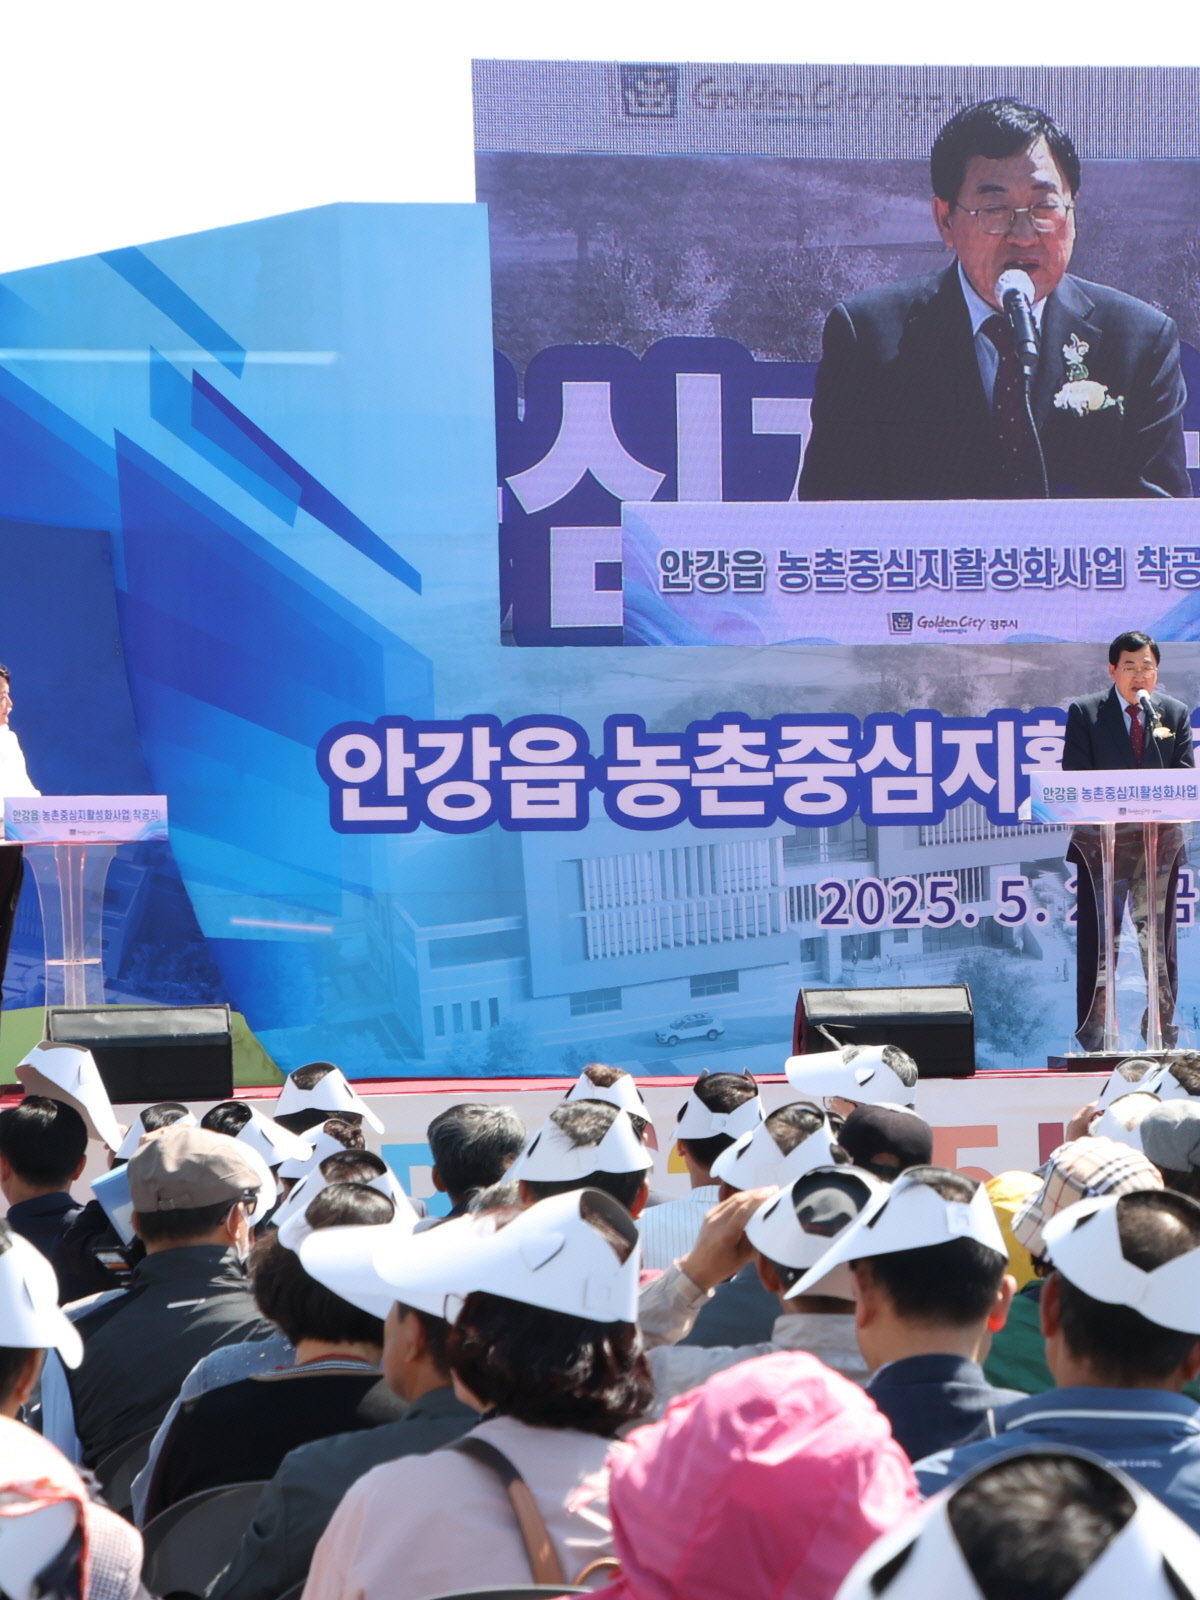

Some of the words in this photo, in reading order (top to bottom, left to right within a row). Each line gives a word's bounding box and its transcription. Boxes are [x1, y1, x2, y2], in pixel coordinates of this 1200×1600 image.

[659, 548, 766, 592] 안강읍
[777, 546, 1125, 591] 농촌중심지활성화사업
[917, 616, 958, 629] Golden
[960, 616, 986, 631] City
[990, 619, 1019, 630] 경주시
[325, 722, 589, 825] 안강읍
[1042, 786, 1077, 801] 안강읍
[1081, 784, 1197, 801] 농촌중심지활성화사업
[12, 809, 40, 822] 안강읍
[42, 808, 131, 822] 농촌중심지활성화사업
[133, 808, 160, 821] 착공식
[817, 877, 978, 928] 2025.
[997, 876, 1049, 926] 5.
